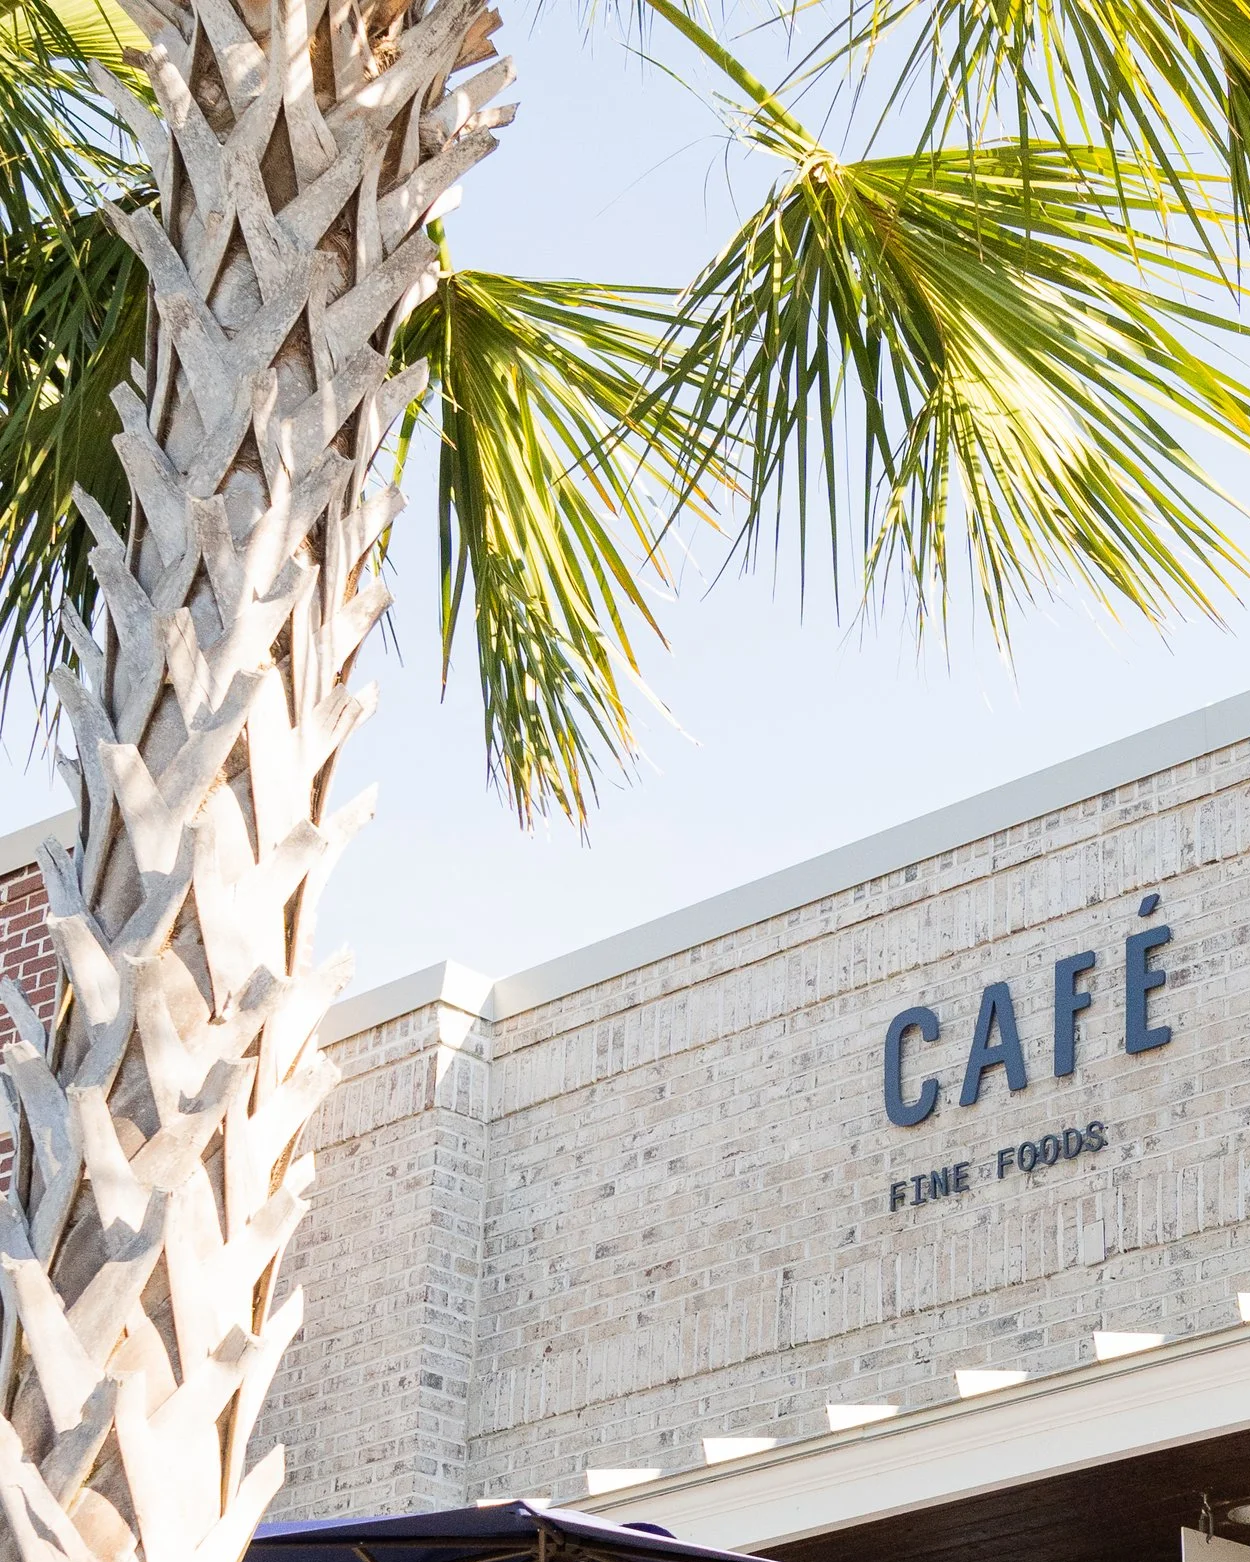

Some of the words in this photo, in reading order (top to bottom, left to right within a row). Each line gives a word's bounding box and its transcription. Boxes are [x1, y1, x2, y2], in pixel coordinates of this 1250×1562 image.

[884, 893, 1172, 1127] CAFÉ
[890, 1161, 970, 1213] FINE
[997, 1120, 1108, 1179] FOODS
